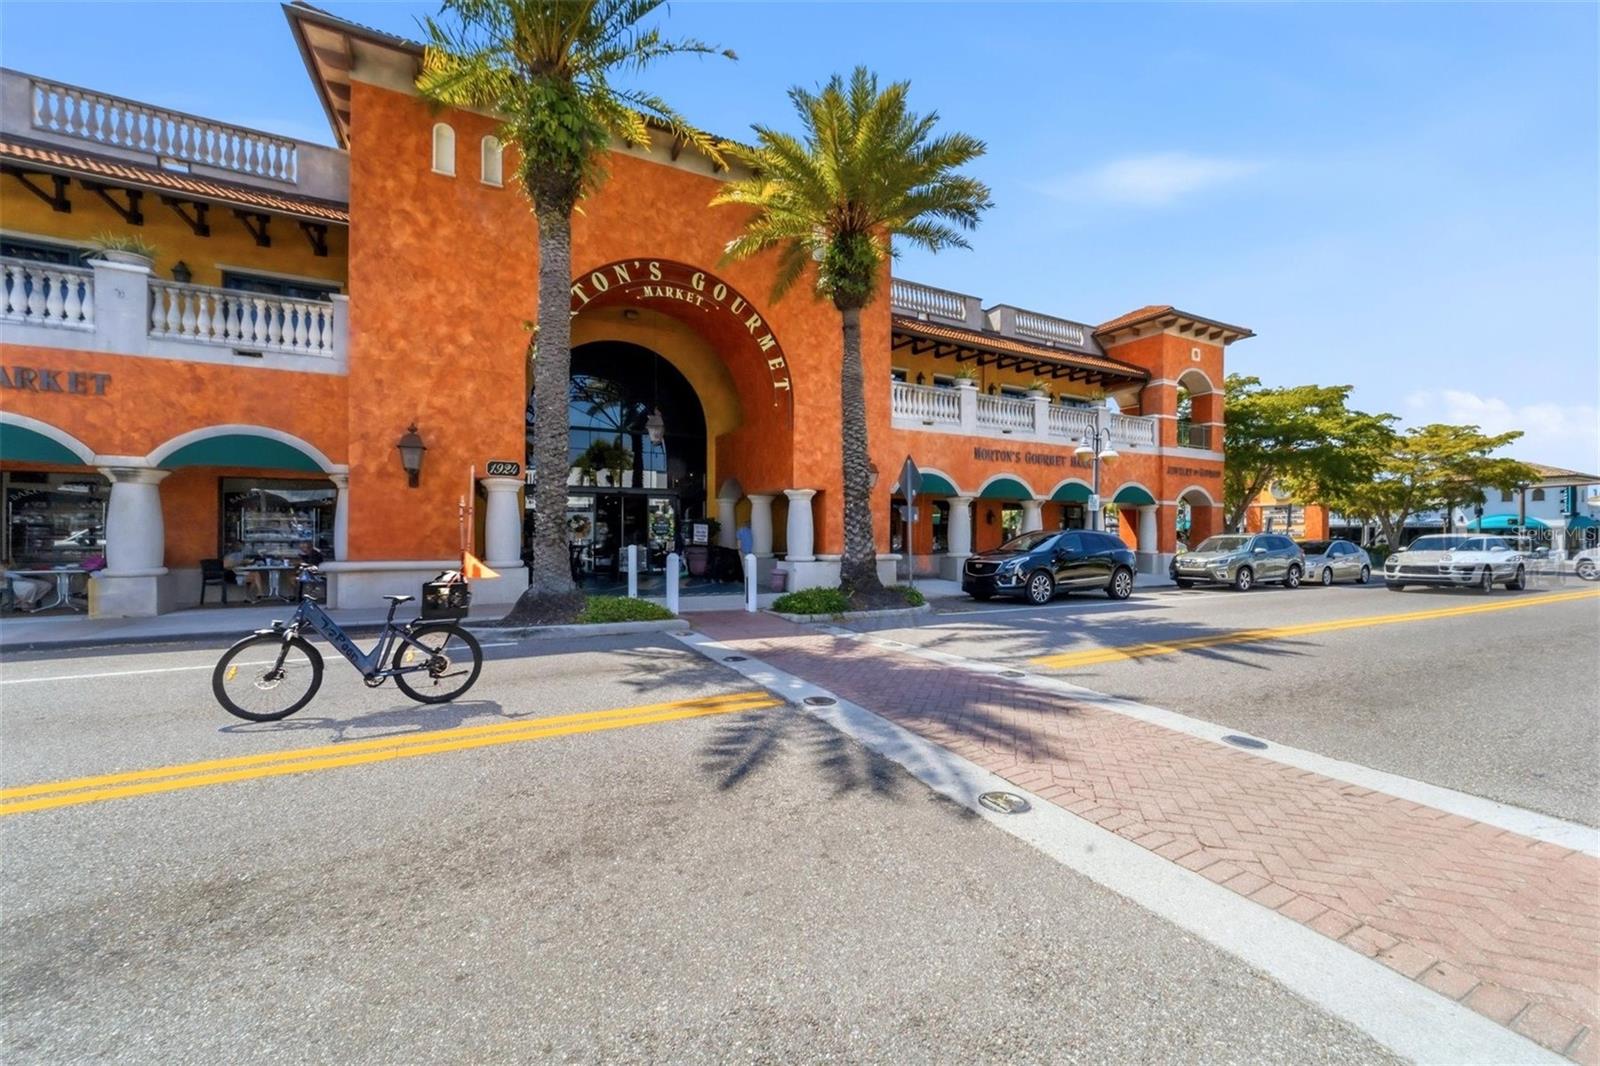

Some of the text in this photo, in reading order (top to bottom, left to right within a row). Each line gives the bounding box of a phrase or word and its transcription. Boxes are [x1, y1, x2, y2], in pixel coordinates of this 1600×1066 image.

[643, 286, 704, 306] MARKET
[570, 261, 790, 391] TON'S GOURMET
[0, 366, 112, 396] ARKET
